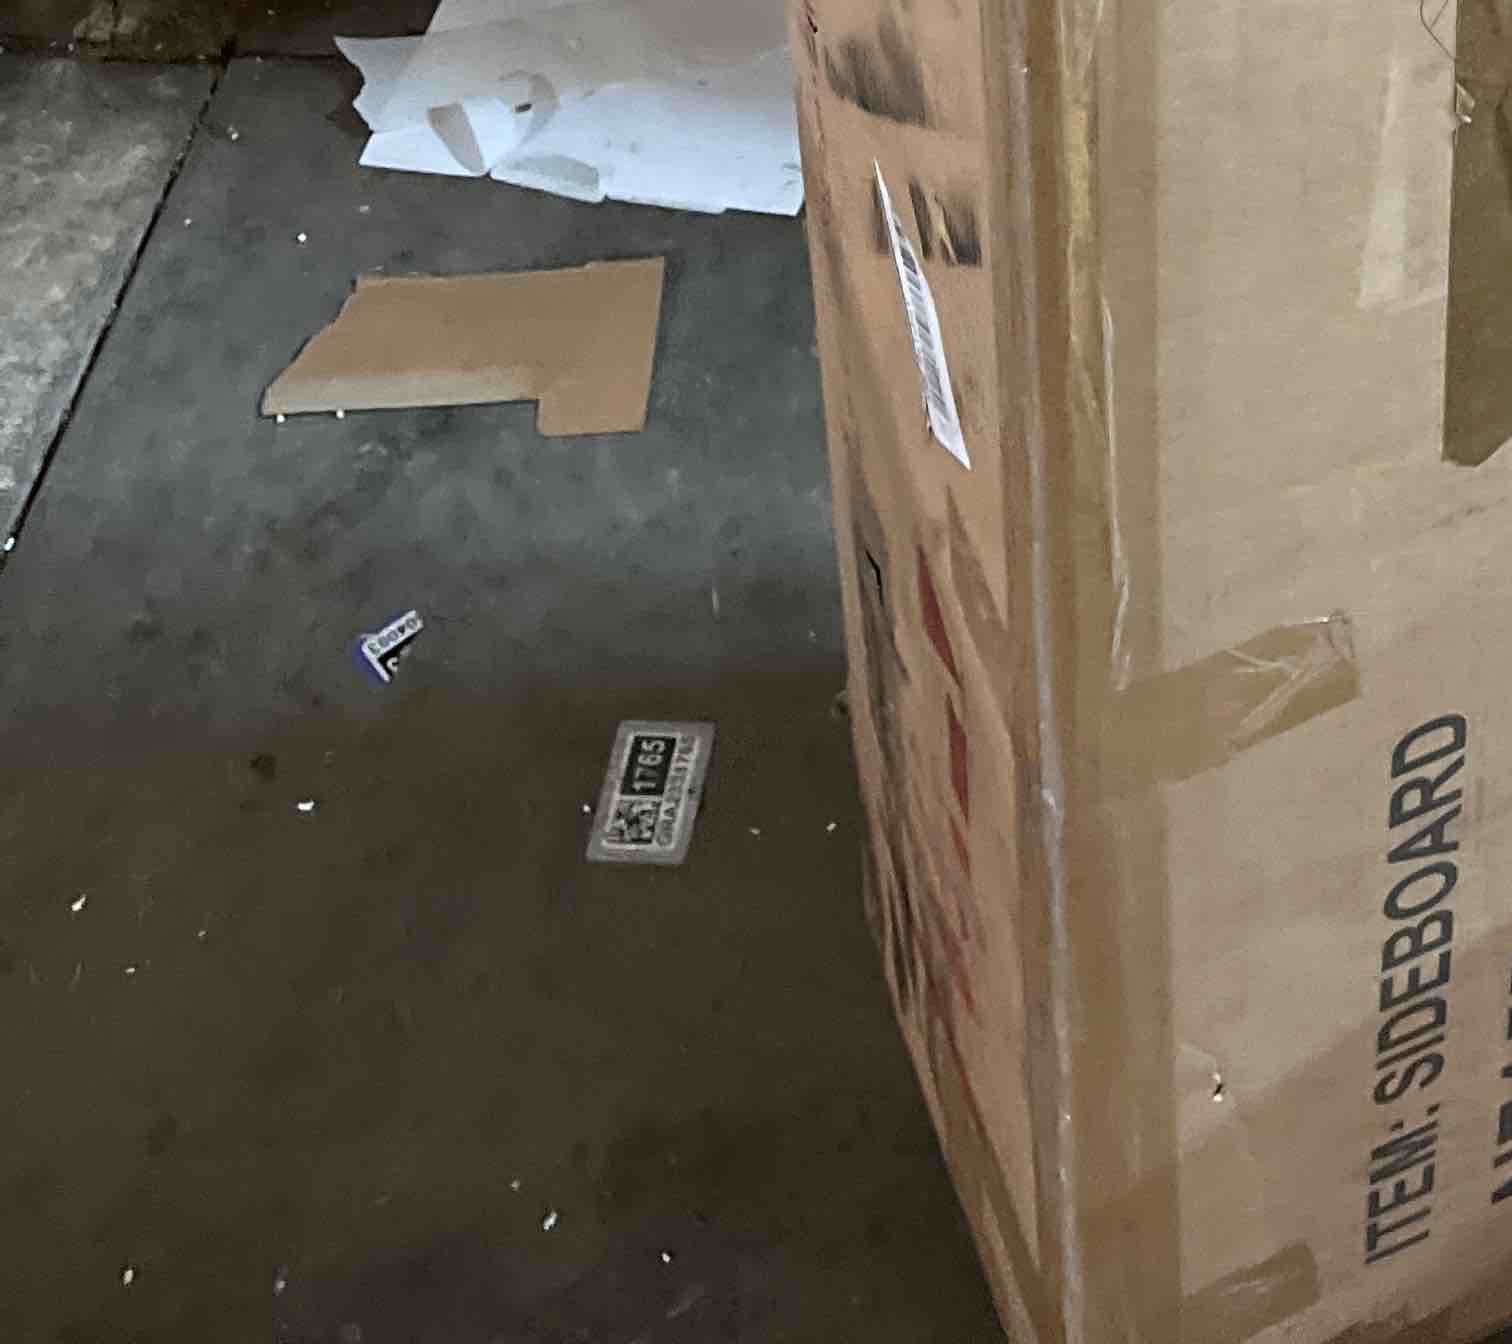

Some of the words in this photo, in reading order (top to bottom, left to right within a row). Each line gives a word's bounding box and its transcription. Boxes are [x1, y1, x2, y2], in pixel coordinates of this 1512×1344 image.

[630, 738, 667, 794] 1765
[1373, 712, 1468, 1105] SIDEBOARD
[1365, 1102, 1441, 1266] ITEM:
